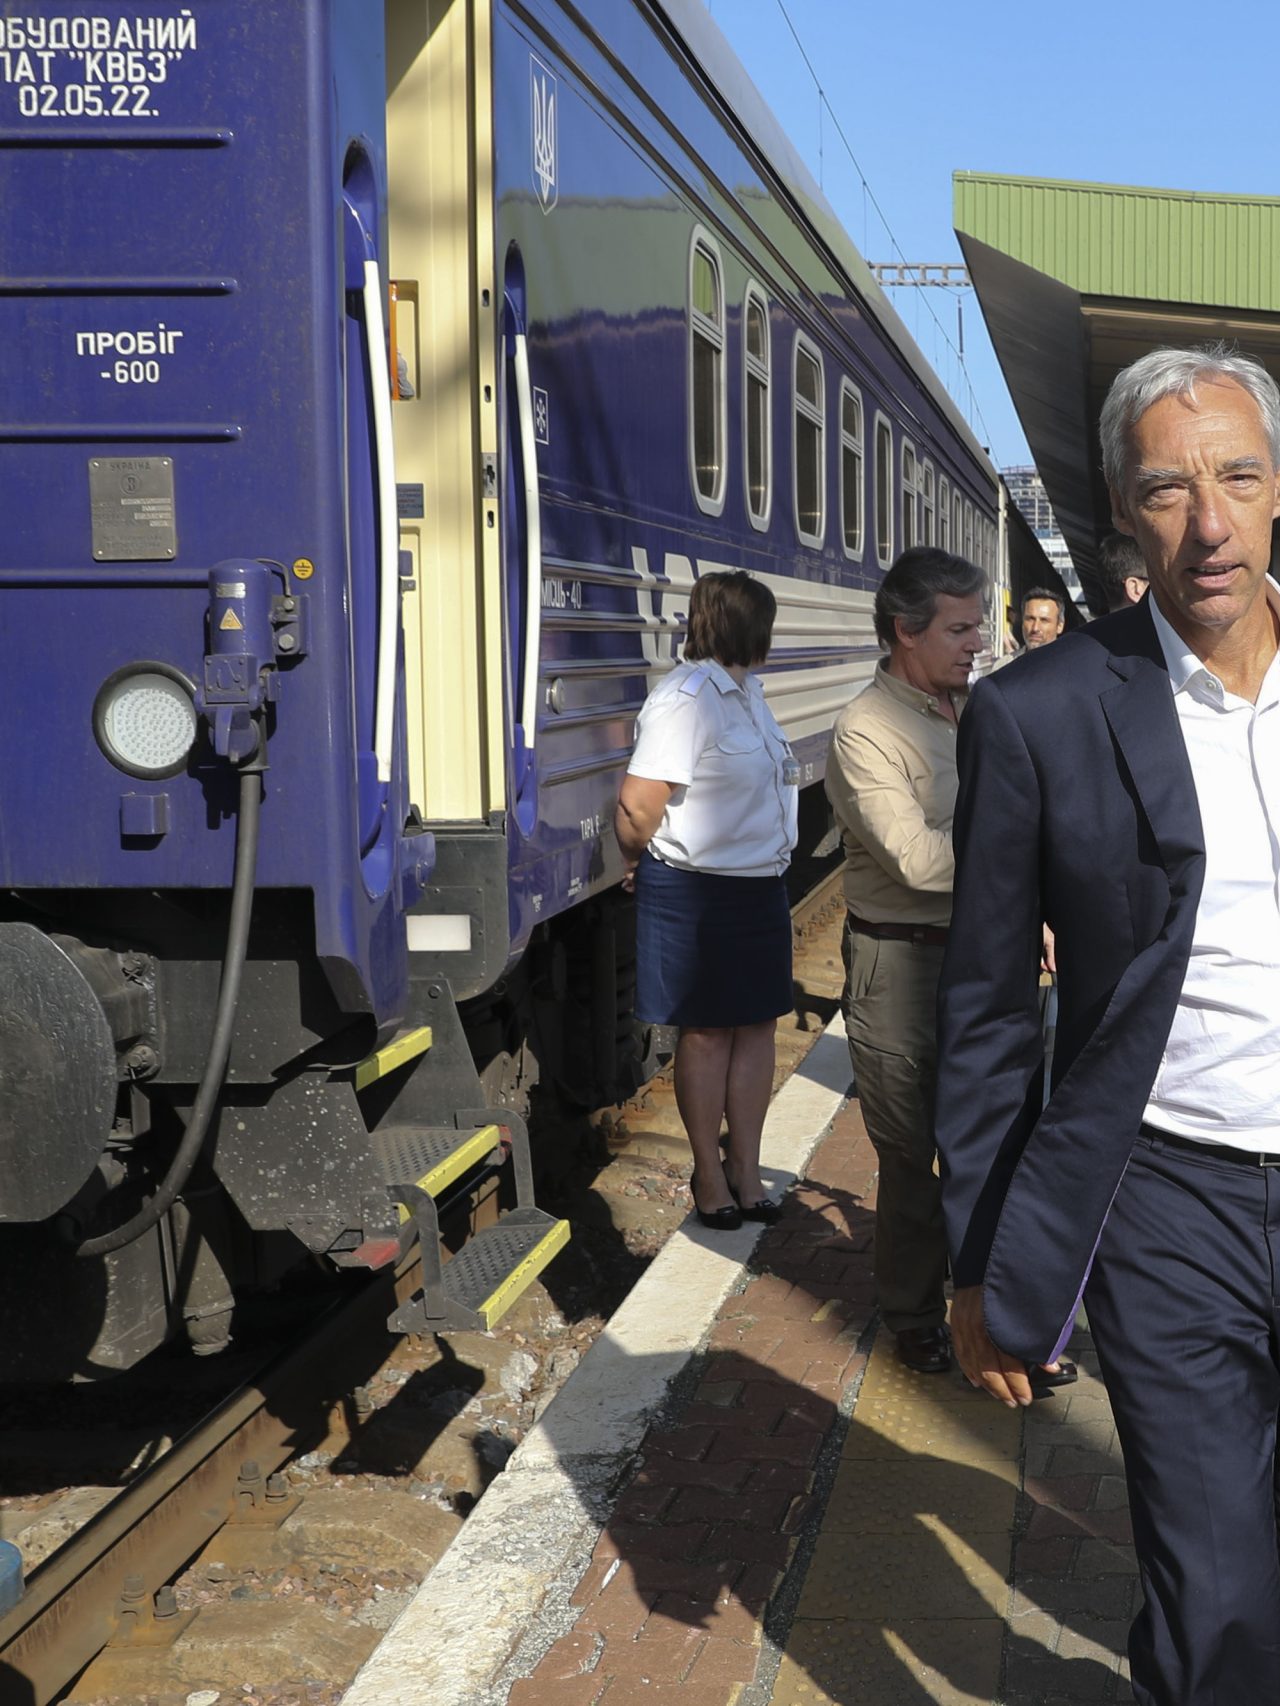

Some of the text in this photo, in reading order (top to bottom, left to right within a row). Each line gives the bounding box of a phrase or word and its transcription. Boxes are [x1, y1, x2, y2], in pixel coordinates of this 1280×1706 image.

[0, 9, 197, 50] БУДОВАНИЙ
[19, 84, 159, 116] 02.05.22.
[101, 361, 159, 383] -600
